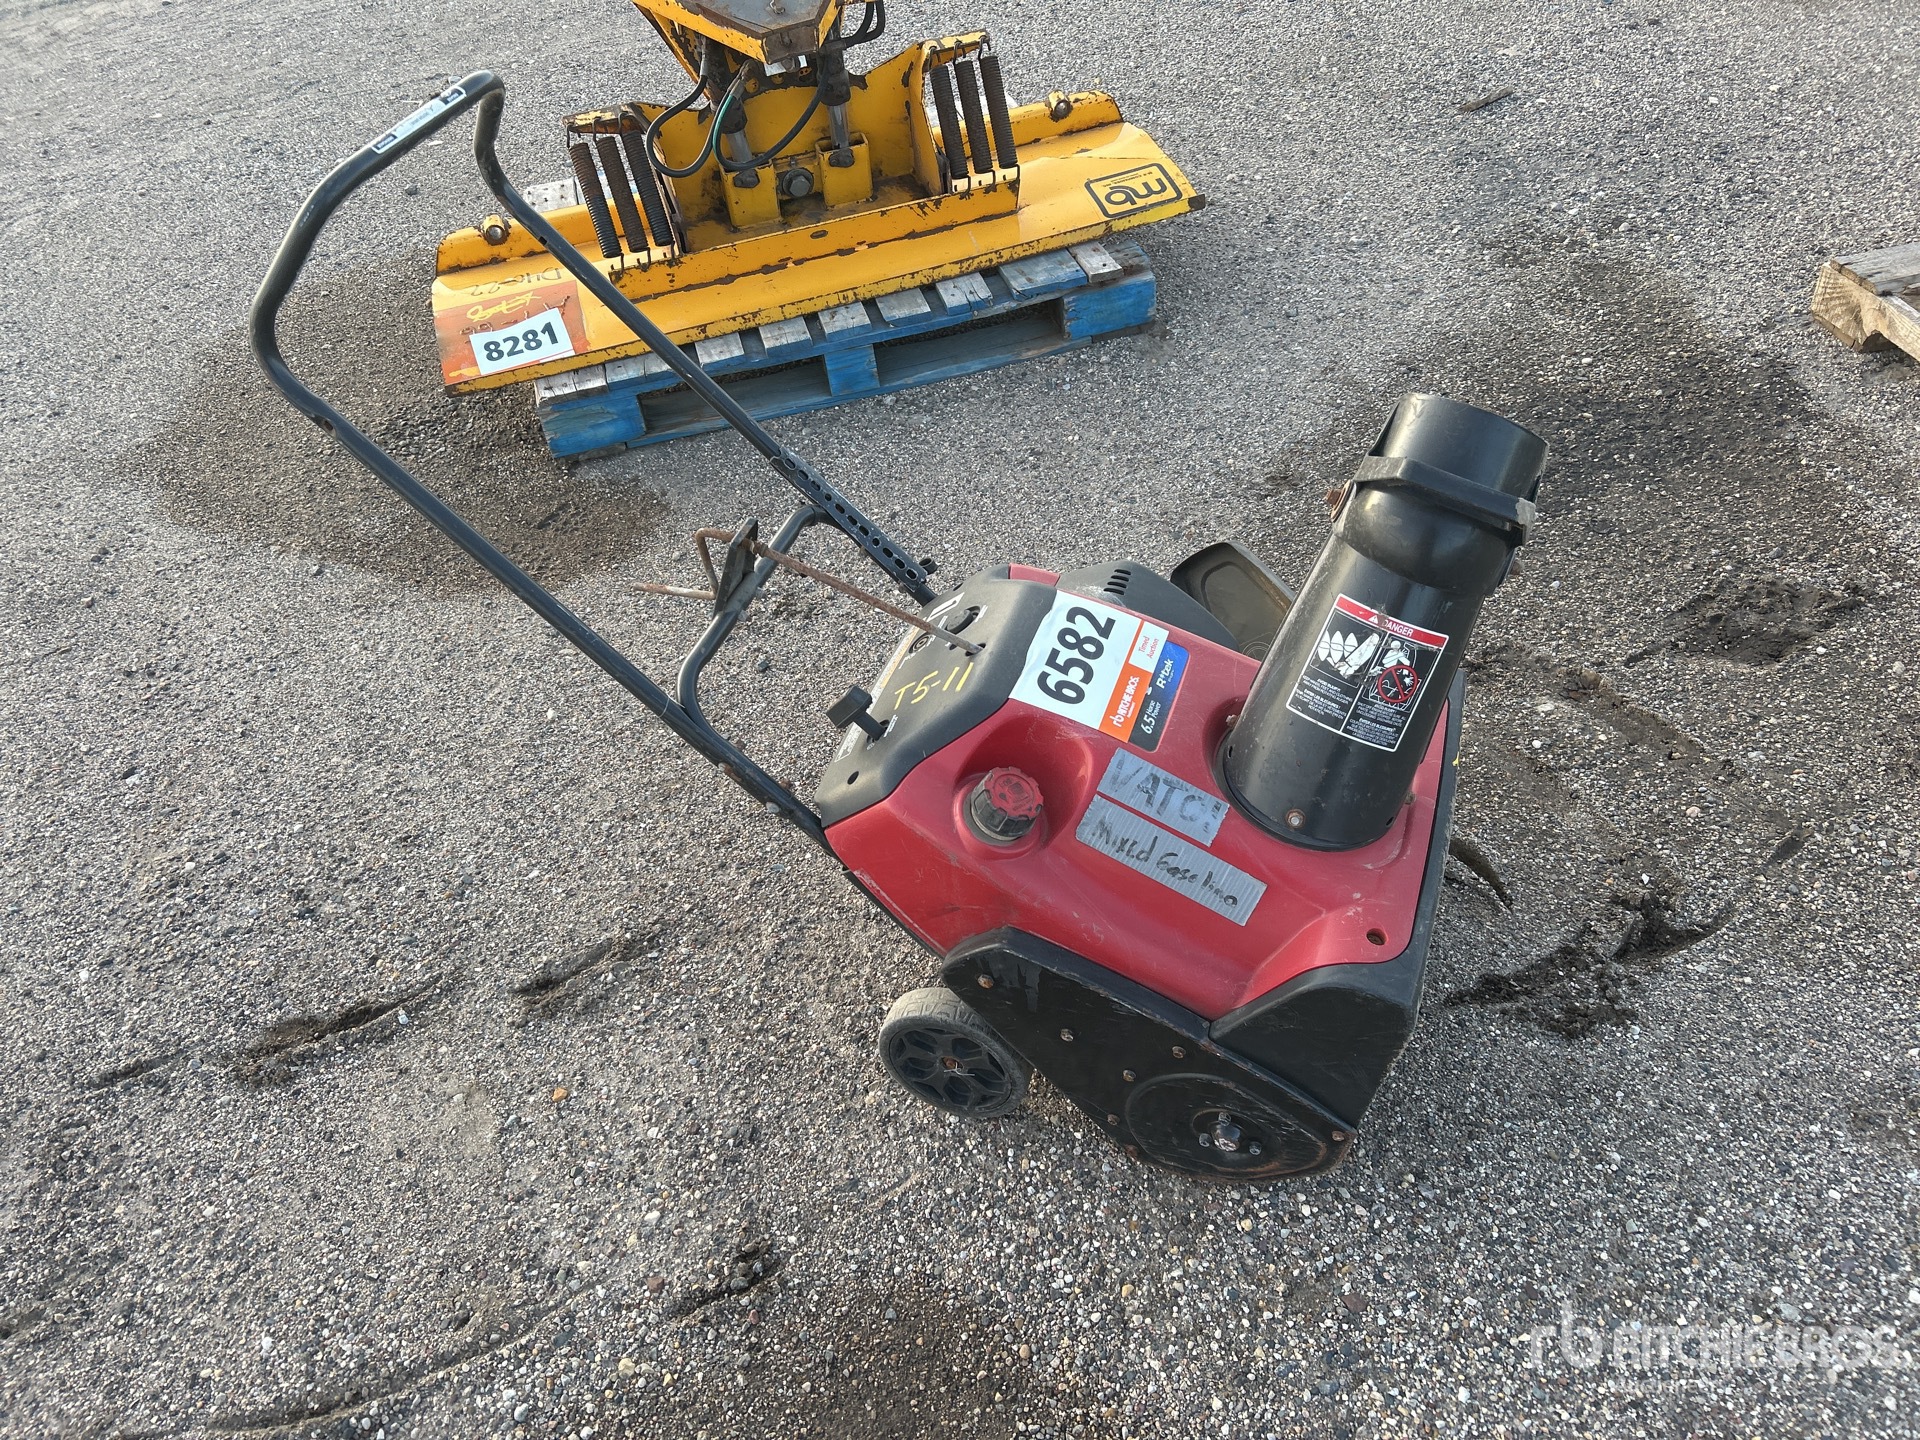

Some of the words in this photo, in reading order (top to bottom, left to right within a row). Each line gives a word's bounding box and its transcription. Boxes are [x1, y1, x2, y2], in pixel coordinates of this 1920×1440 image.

[483, 321, 559, 362] 8281
[1138, 635, 1150, 653] Timed
[1146, 638, 1160, 659] Auction
[1037, 606, 1116, 704] 6582
[1145, 700, 1156, 715] Horse
[1151, 701, 1162, 719] Power
[1141, 714, 1156, 734] 6.5
